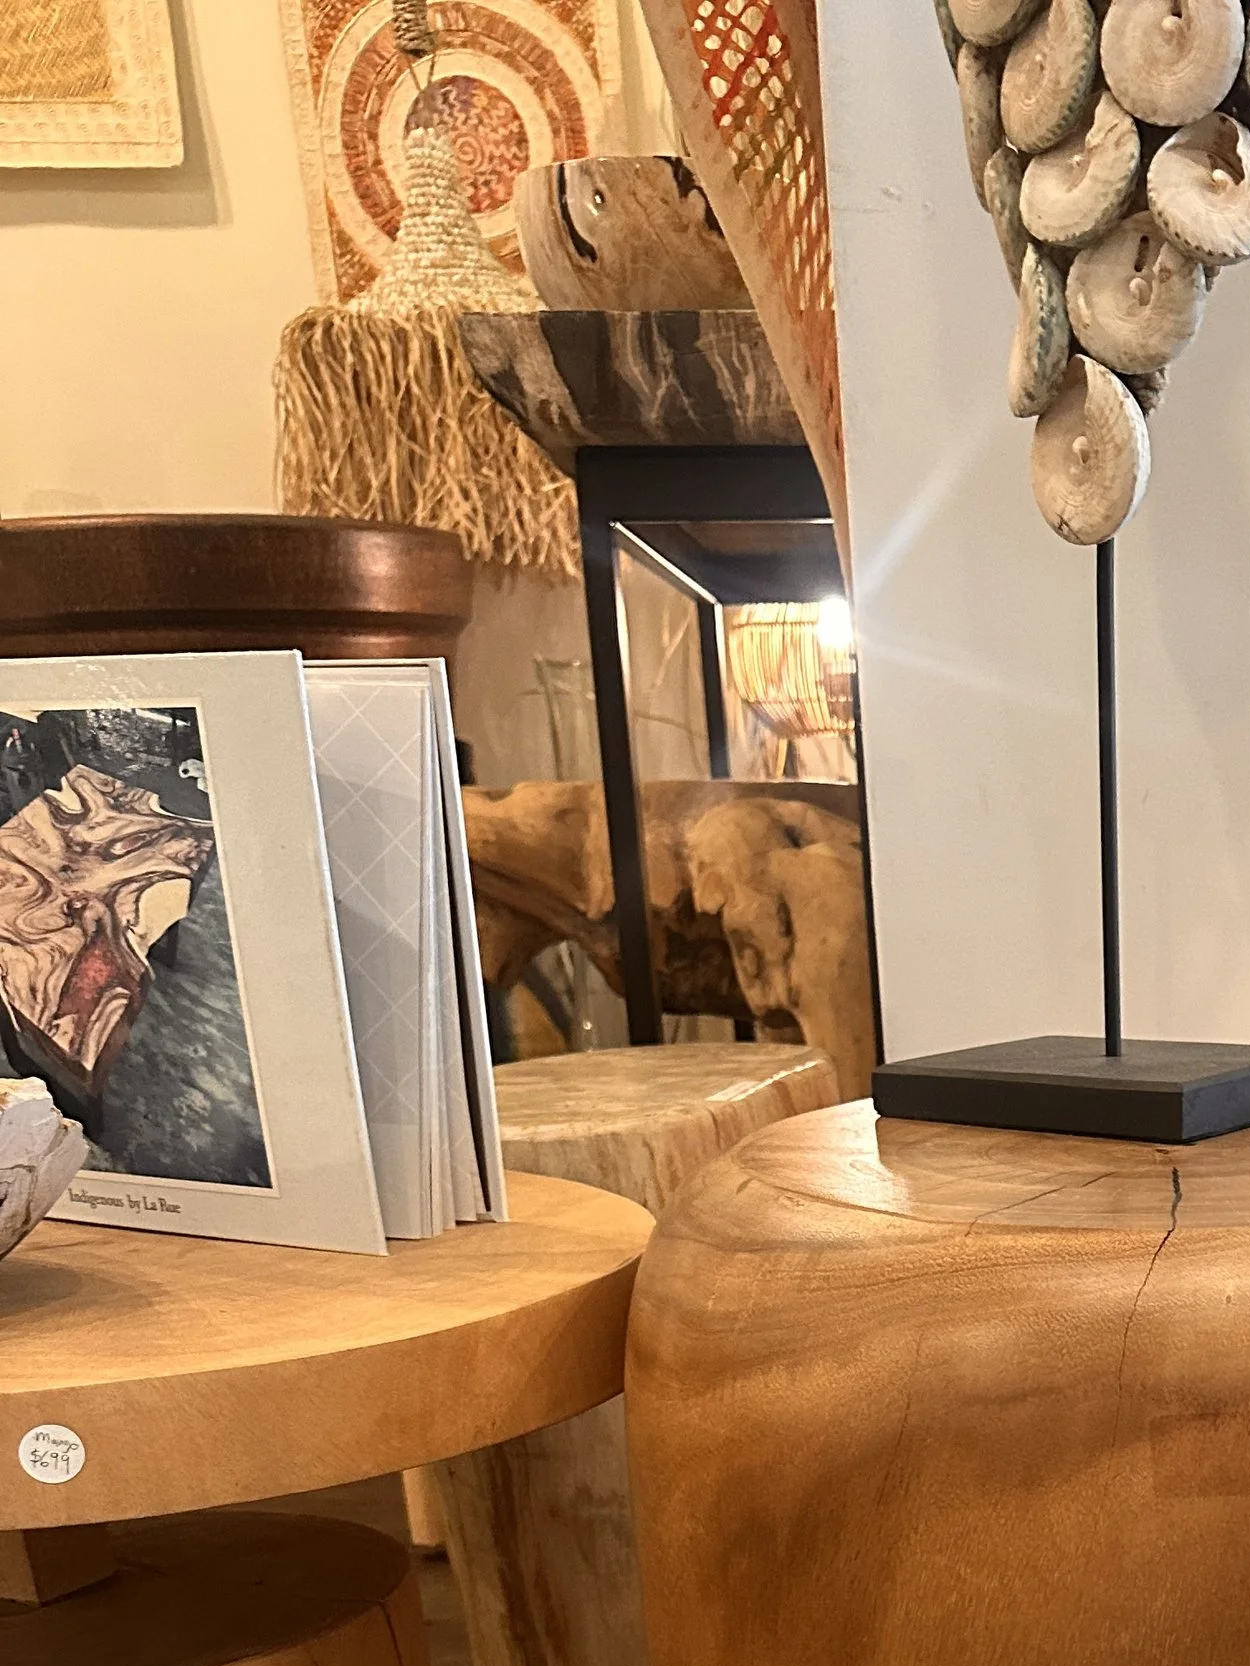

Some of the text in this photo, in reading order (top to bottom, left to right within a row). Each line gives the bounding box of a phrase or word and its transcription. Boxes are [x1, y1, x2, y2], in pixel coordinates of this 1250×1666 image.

[68, 1188, 124, 1209] Indigenous
[127, 1194, 141, 1214] by
[143, 1196, 158, 1211] La
[30, 1448, 69, 1475] $699
